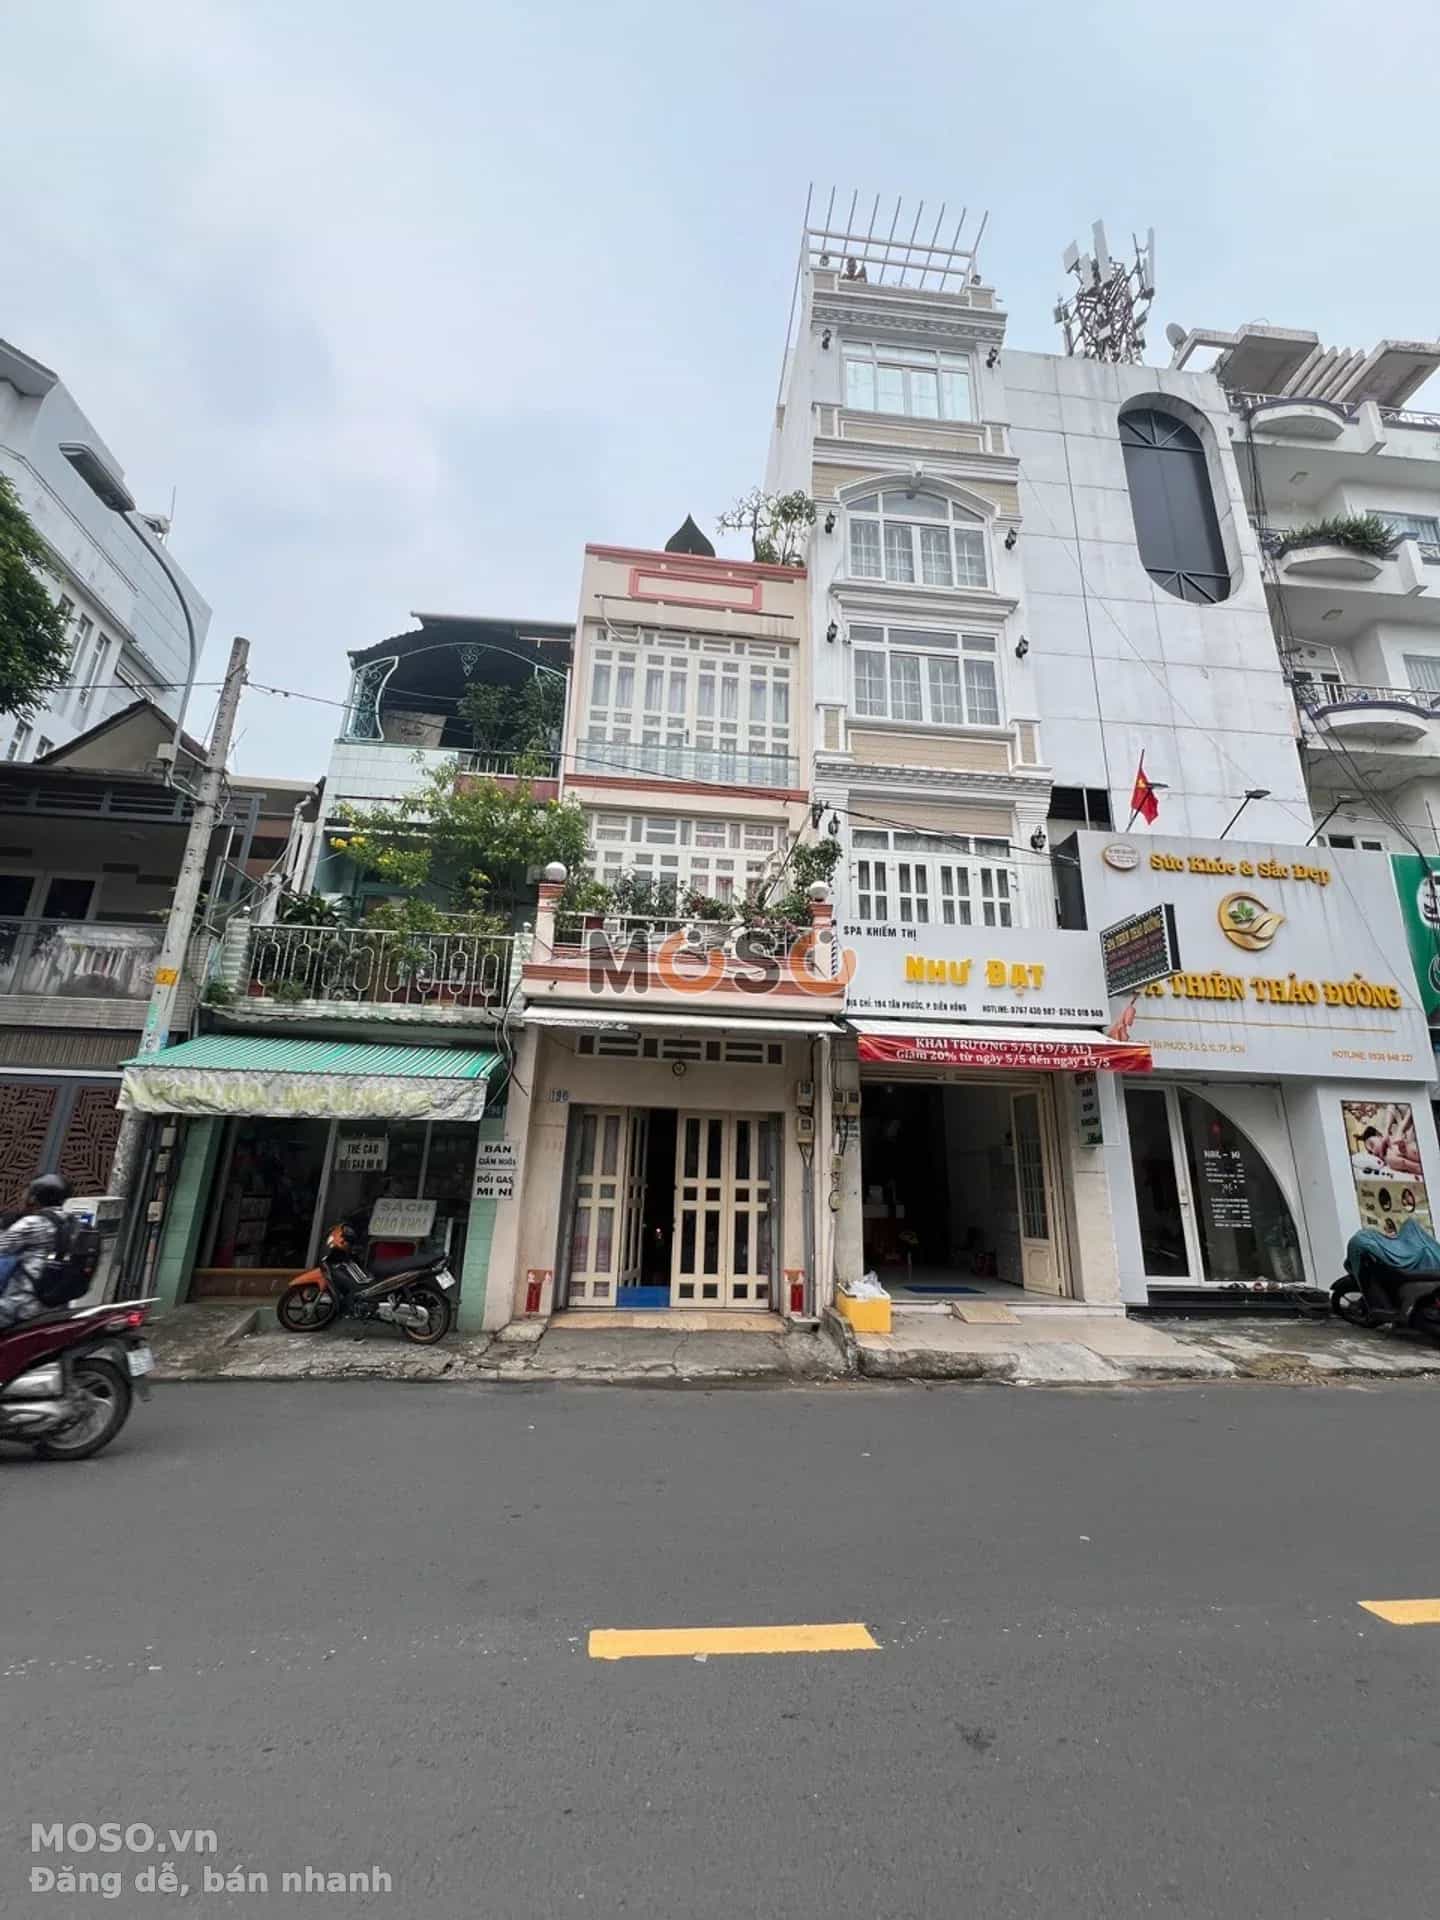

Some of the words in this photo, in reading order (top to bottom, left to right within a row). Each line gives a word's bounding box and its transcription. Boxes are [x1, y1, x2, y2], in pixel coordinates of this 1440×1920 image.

[1240, 860, 1254, 876] &
[1258, 859, 1288, 878] Sắc
[1294, 864, 1330, 885] Đẹp
[843, 925, 862, 936] SPA
[867, 925, 897, 938] KHIẾM
[901, 928, 917, 941] THỊ
[904, 955, 973, 985] NHƯ
[985, 959, 1046, 997] ĐẠT
[1168, 970, 1246, 1001] THIÊN
[1250, 973, 1321, 1006] THẢO
[1323, 973, 1402, 1010] ĐƯỜNG
[982, 1005, 1008, 1014] HOTLINE:
[916, 1038, 948, 1050] KHAI
[950, 1039, 1008, 1052] TRƯƠNG
[896, 1049, 928, 1060] Giảm
[930, 1051, 957, 1062] 20%
[959, 1051, 974, 1062] từ
[976, 1052, 1003, 1066] ngày
[1005, 1053, 1026, 1065] 5/5
[1028, 1052, 1051, 1065] đến
[1082, 1056, 1111, 1069] 15/5
[496, 1175, 513, 1184] GAS
[476, 1187, 493, 1196] MI
[498, 1188, 512, 1196] NI
